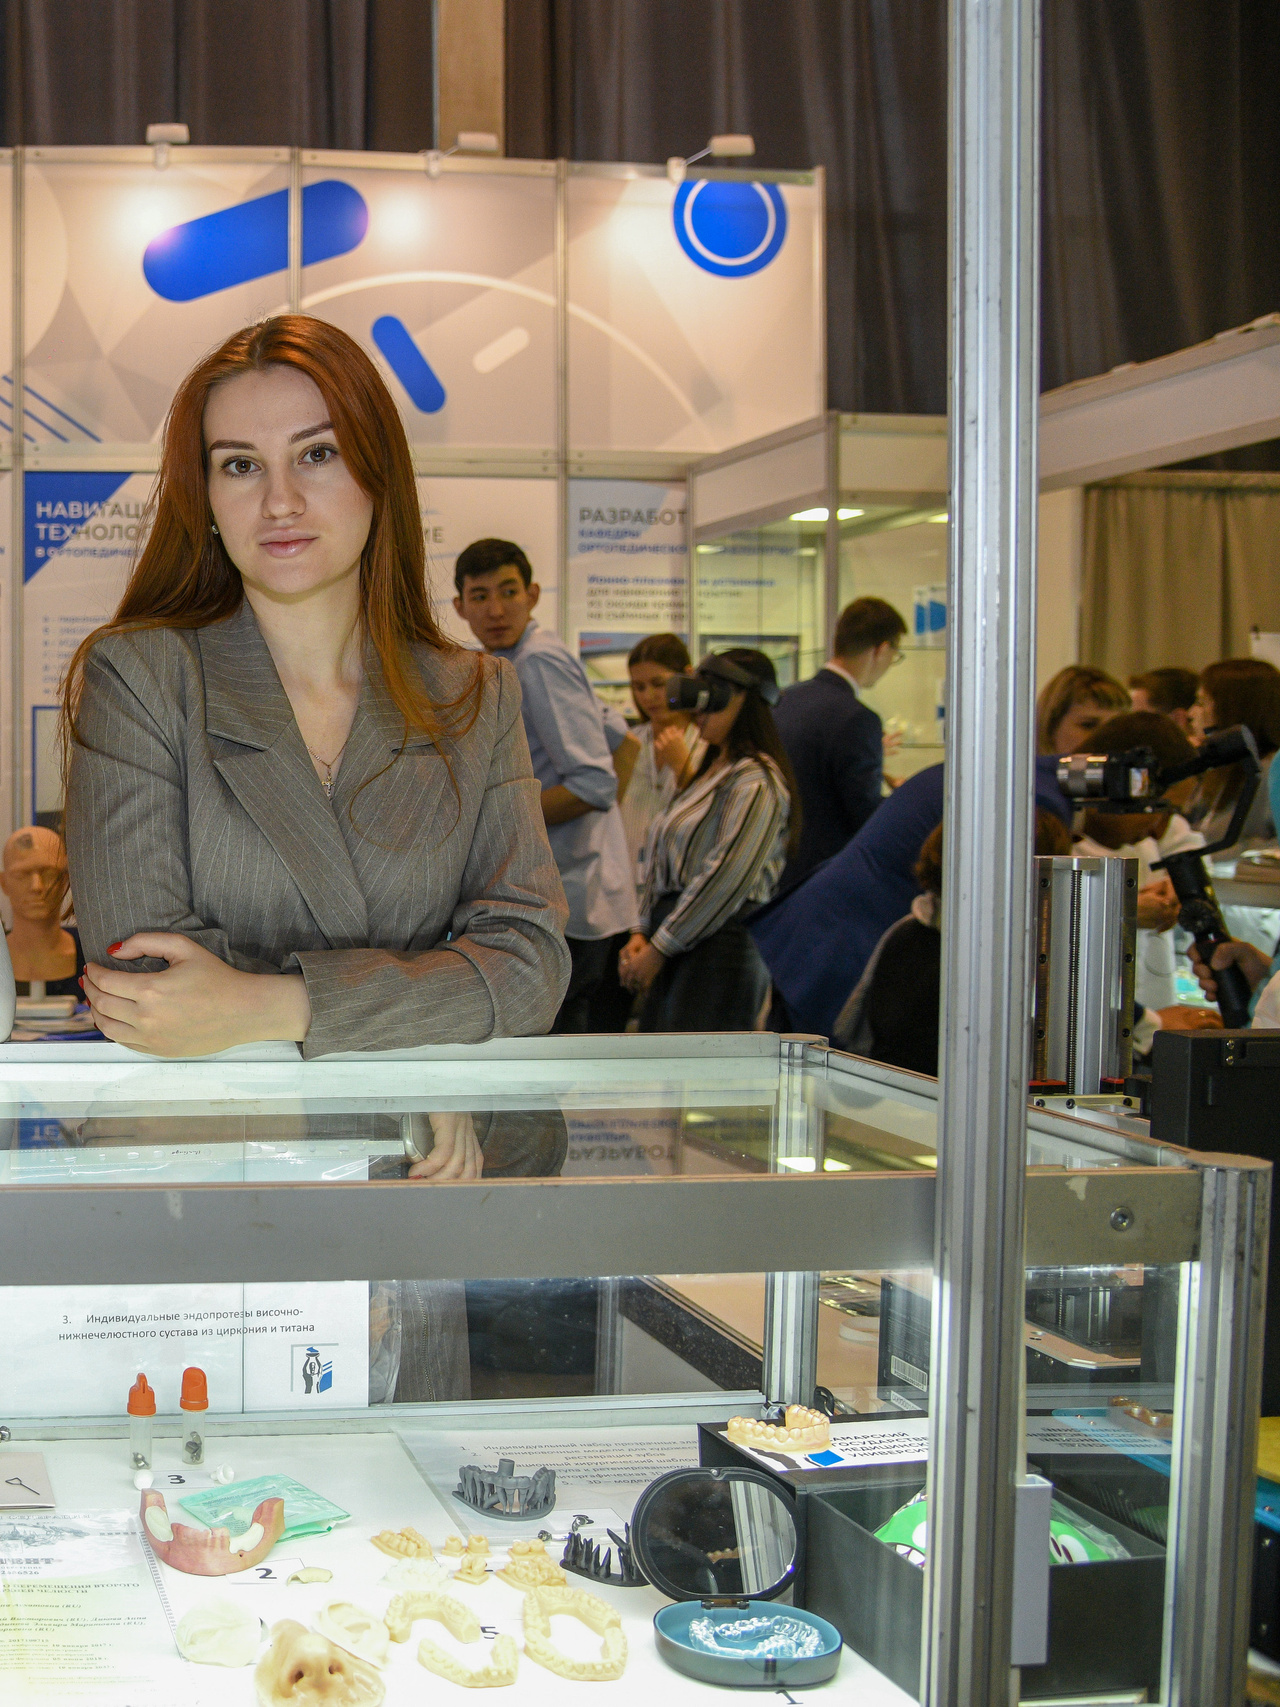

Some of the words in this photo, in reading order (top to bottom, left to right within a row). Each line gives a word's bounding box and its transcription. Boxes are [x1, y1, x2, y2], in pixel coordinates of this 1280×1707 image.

[62, 1315, 72, 1325] 3.
[86, 1311, 181, 1324] Индивидуальные
[183, 1309, 253, 1323] эндопротезы
[255, 1308, 304, 1318] височно-
[58, 1327, 157, 1341] нижнечелюстного
[159, 1328, 199, 1338] сустава
[201, 1328, 214, 1337] из
[216, 1325, 268, 1339] циркония
[280, 1323, 316, 1333] титана
[830, 1431, 909, 1442] АМАРСКИЙ
[483, 1442, 578, 1451] Индивидуальный
[614, 1440, 676, 1448] прозрачных
[493, 1449, 581, 1457] Тренировочные
[574, 1458, 654, 1467] хирургический
[168, 1474, 186, 1485] 3
[255, 1567, 277, 1579] 2
[480, 1626, 500, 1639] 5
